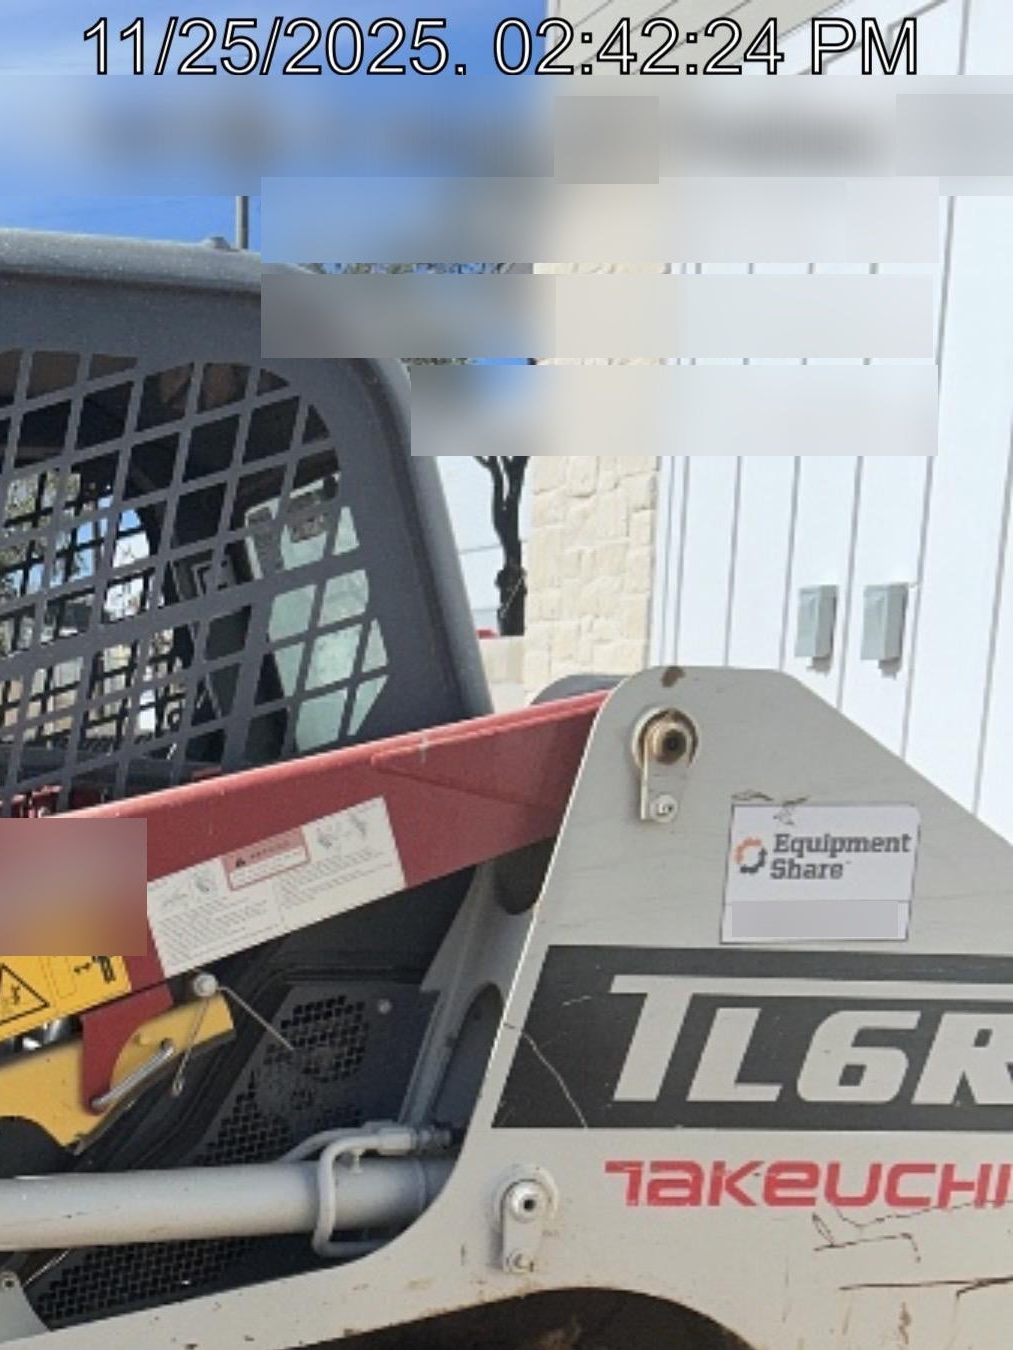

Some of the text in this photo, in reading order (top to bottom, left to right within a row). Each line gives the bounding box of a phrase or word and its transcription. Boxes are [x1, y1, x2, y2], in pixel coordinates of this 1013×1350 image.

[772, 833, 912, 859] Equipment
[769, 858, 845, 881] Share
[609, 974, 1013, 1105] TL6R
